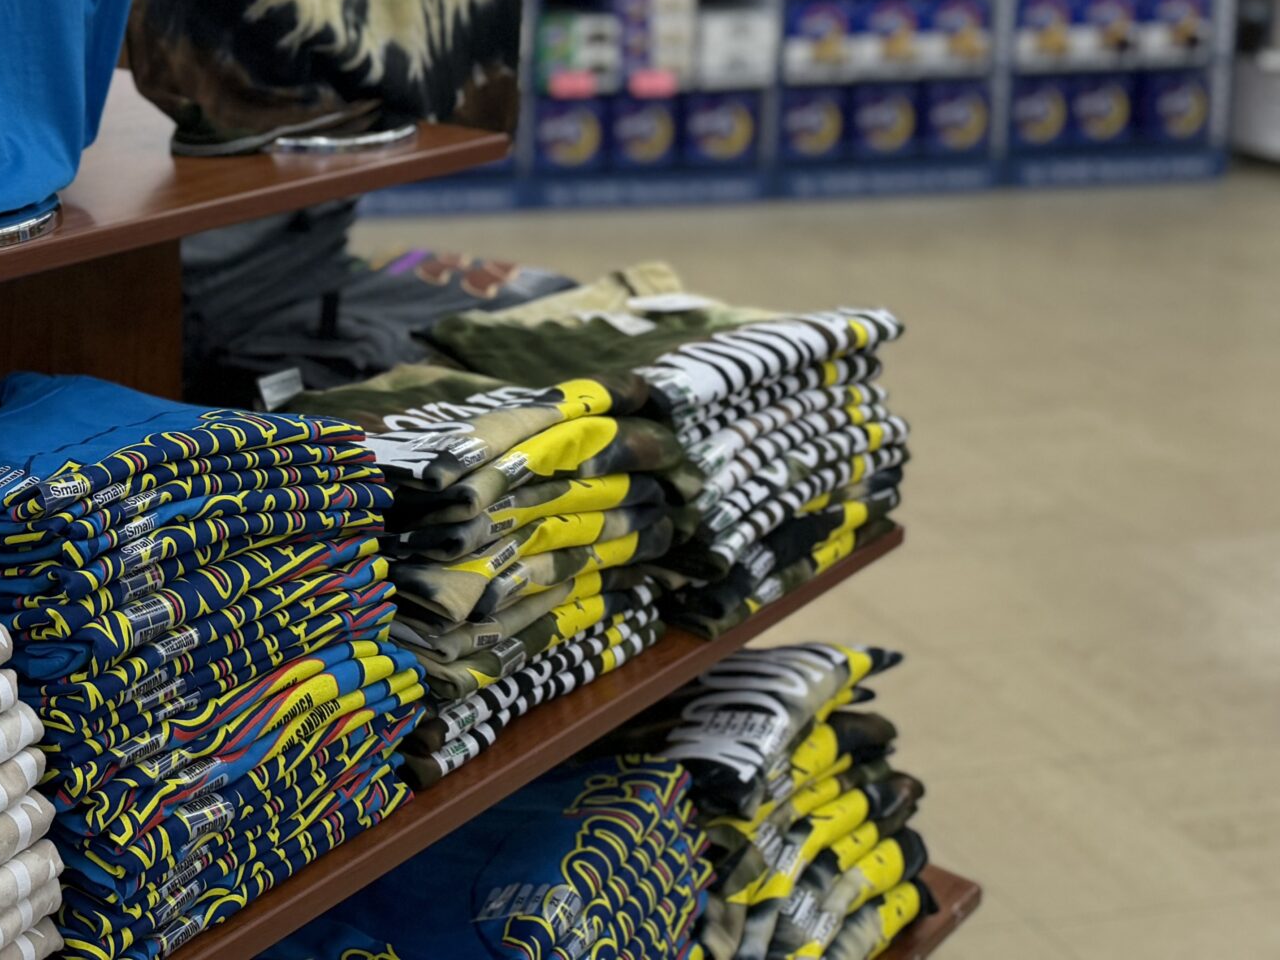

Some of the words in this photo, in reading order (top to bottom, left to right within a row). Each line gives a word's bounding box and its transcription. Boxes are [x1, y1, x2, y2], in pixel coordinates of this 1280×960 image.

[51, 481, 87, 497] Small
[93, 483, 126, 504] Small
[126, 517, 154, 538] Small
[122, 536, 154, 554] Small
[295, 698, 342, 742] SANDWICH
